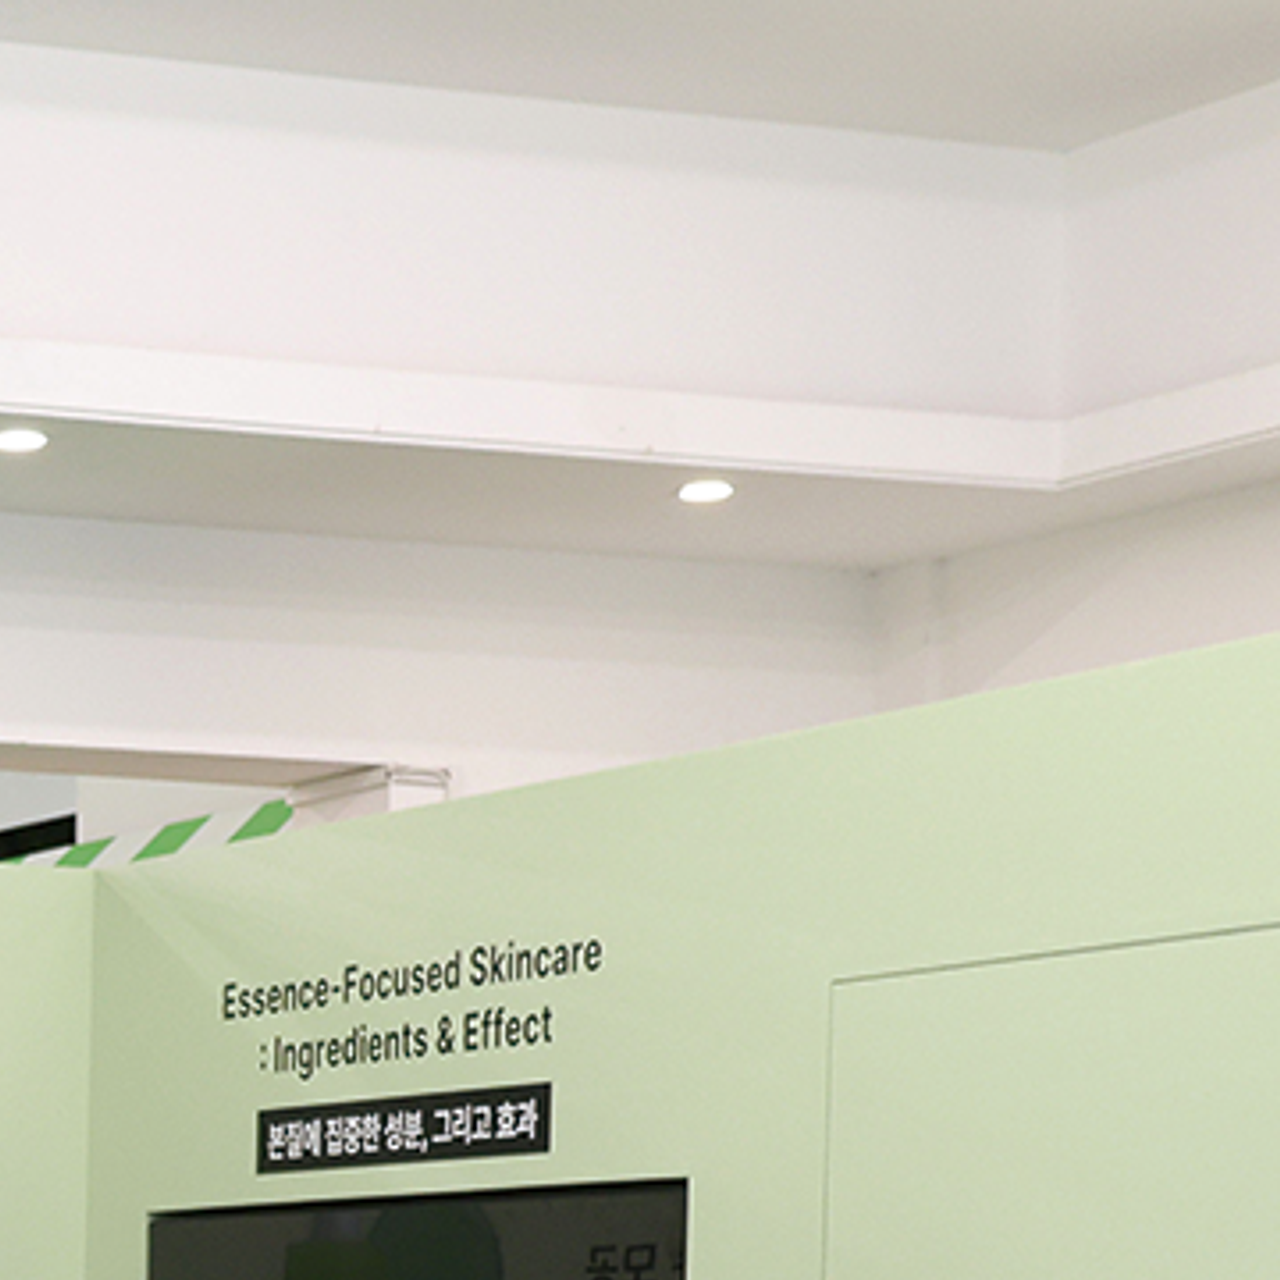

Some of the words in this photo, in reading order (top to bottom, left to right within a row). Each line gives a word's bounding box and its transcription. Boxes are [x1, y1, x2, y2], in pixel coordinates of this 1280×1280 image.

[222, 949, 460, 1021] Essence-Focused
[469, 938, 603, 988] Skincare
[273, 1023, 429, 1081] Ingredients
[437, 1015, 454, 1055] &
[463, 1005, 552, 1052] Effect
[266, 1118, 323, 1161] 본질에
[324, 1111, 381, 1157] 집중한
[432, 1101, 492, 1146] 그리고
[495, 1097, 539, 1140] 효과
